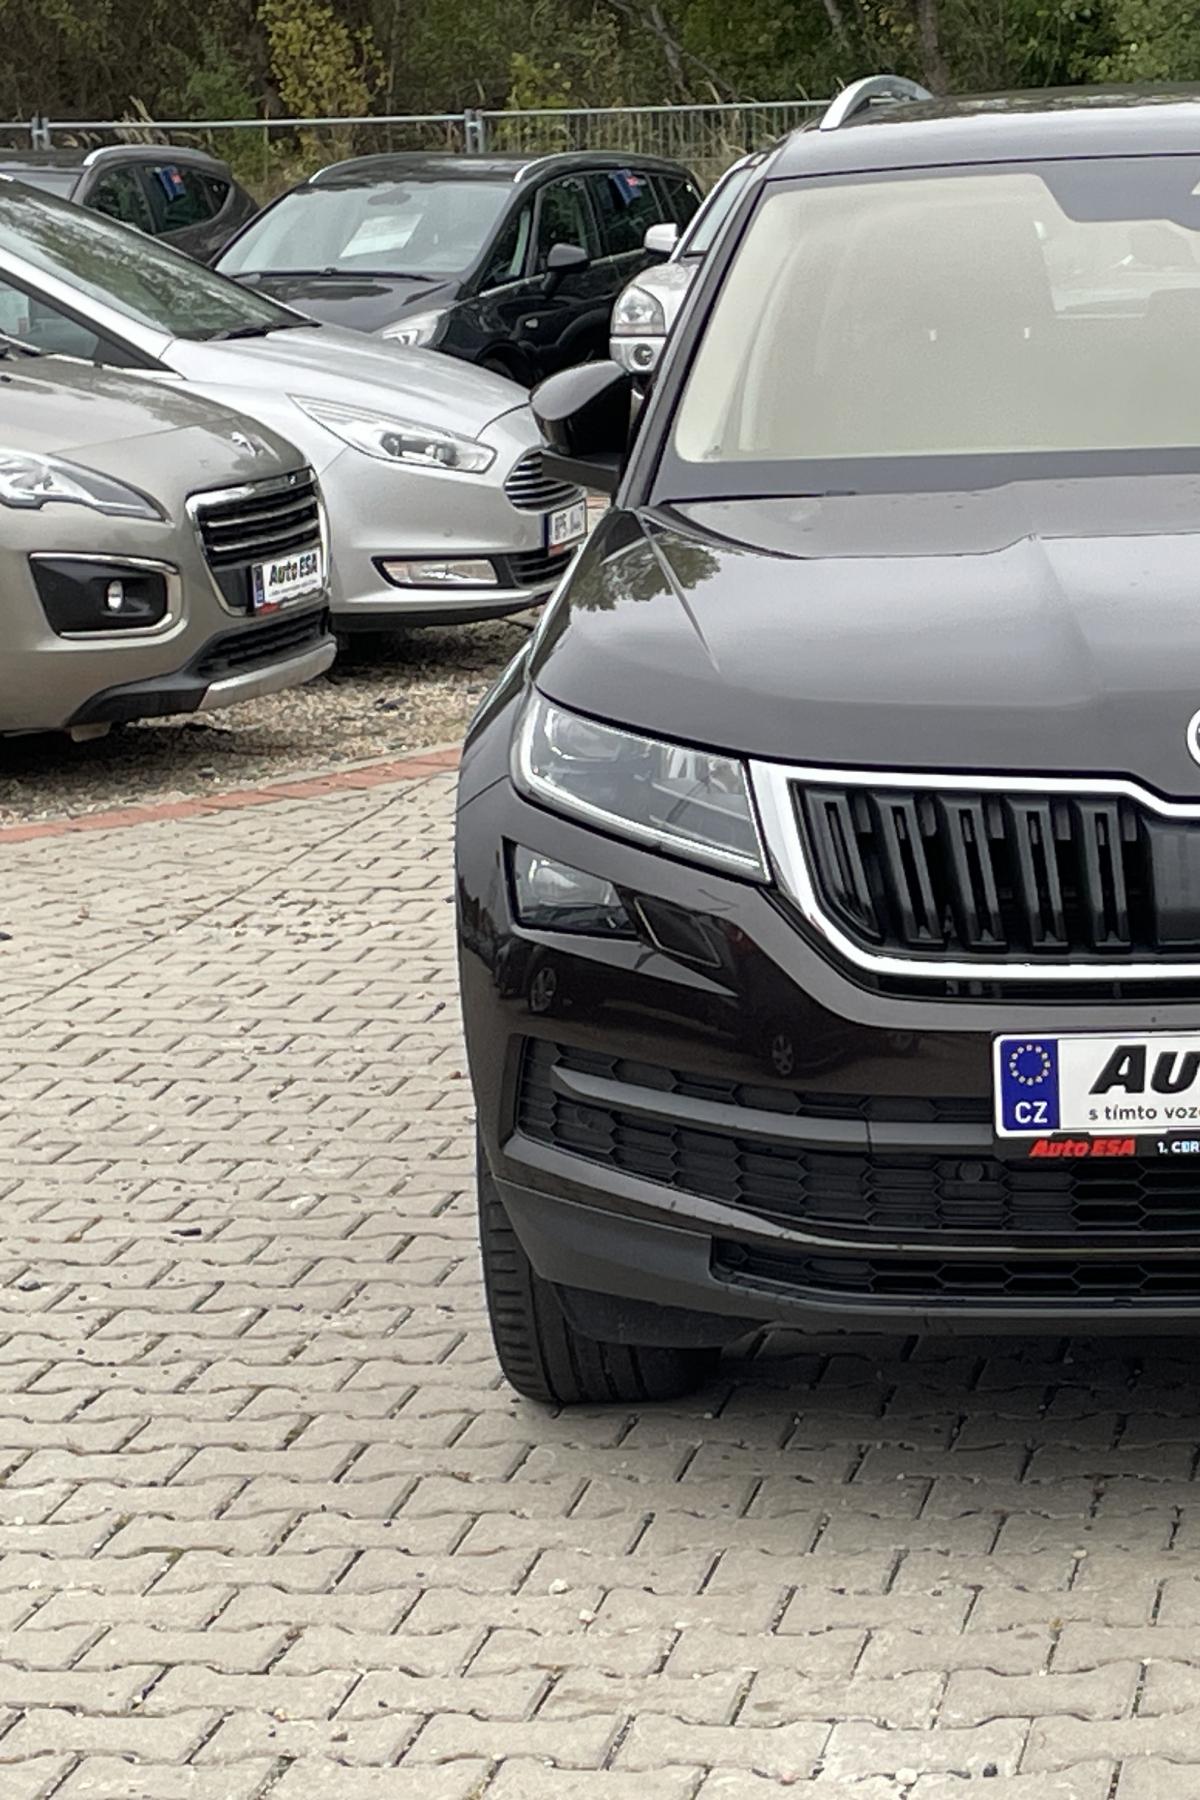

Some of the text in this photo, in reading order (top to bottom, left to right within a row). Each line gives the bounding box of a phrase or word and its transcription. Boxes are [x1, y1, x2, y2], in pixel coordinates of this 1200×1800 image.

[268, 553, 318, 587] Auto ESA
[1015, 1101, 1048, 1124] CZ
[1089, 1109, 1098, 1121] s
[1104, 1103, 1157, 1120] tímto
[1029, 1137, 1135, 1157] Auto ESA
[1157, 1142, 1169, 1154] 1.
